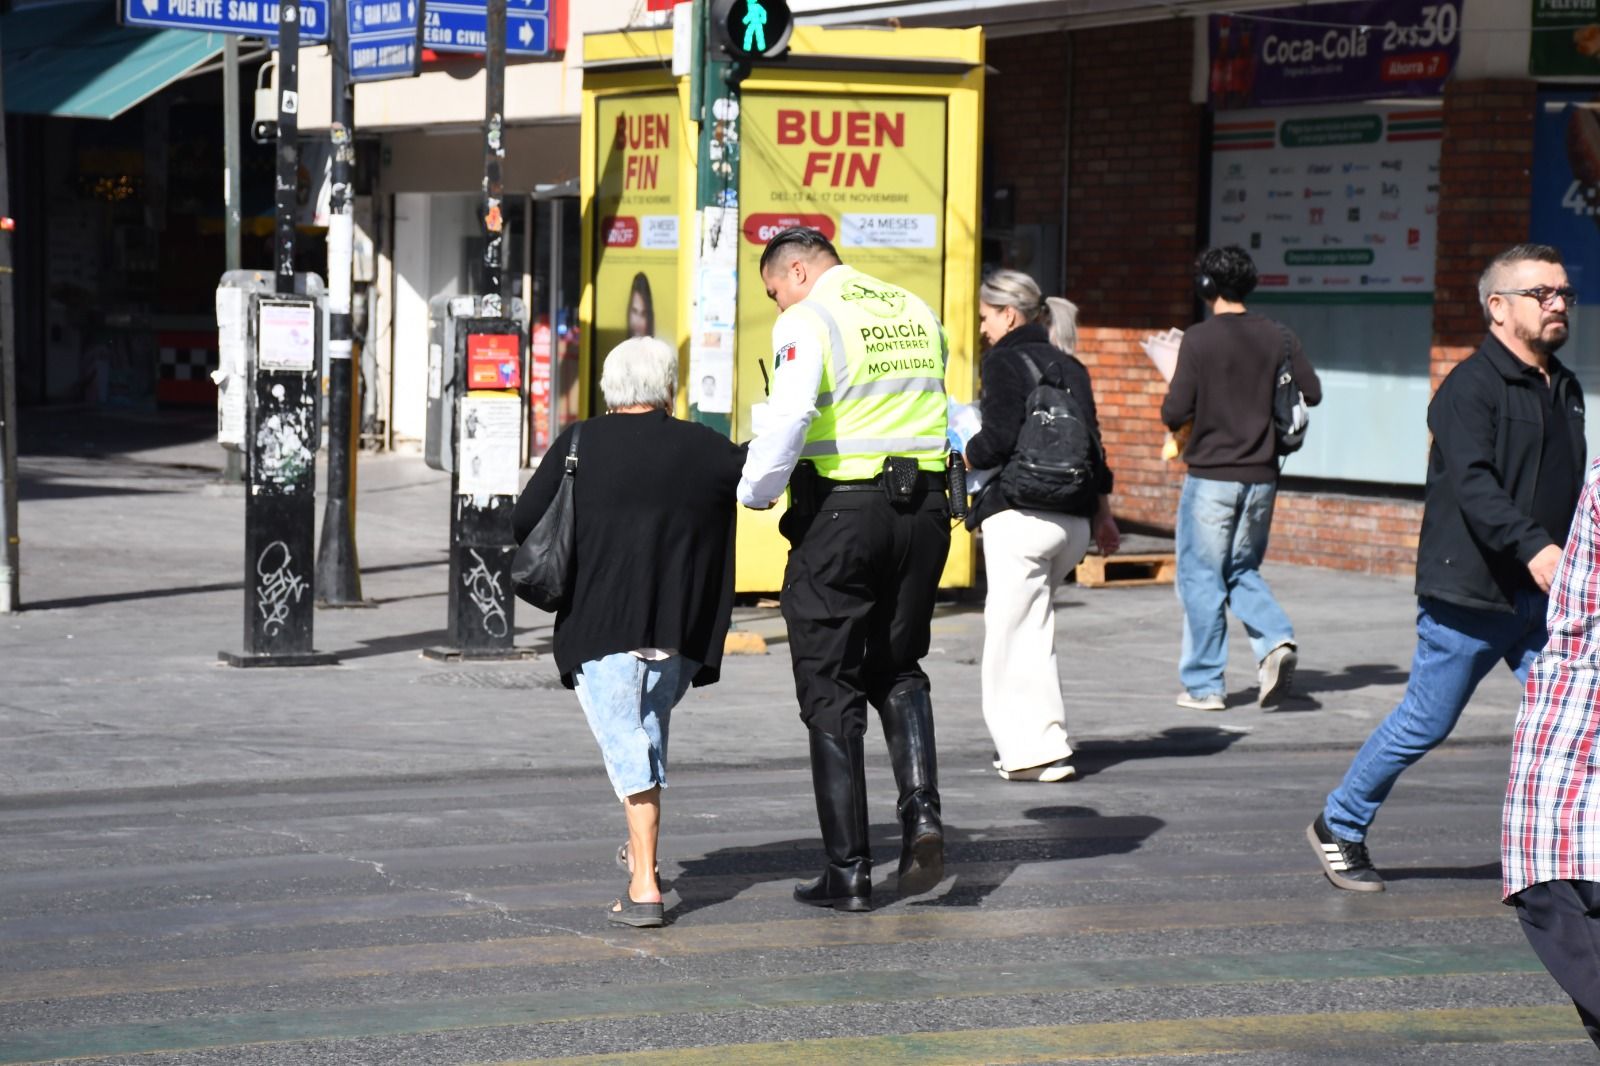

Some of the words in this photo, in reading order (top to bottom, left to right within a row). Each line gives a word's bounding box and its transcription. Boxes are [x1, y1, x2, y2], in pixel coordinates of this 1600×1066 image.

[168, 0, 223, 19] PUENTE
[228, 1, 258, 22] SAN
[263, 3, 316, 28] LUTO
[456, 29, 487, 46] CIVIL
[1262, 28, 1368, 64] Coca-Cola
[1388, 60, 1424, 76] Ahorra
[616, 114, 669, 150] BUEN
[777, 110, 904, 147] BUEN
[625, 155, 658, 190] FIN
[803, 152, 881, 187] FIN
[770, 192, 788, 202] DEL
[834, 192, 846, 202] DE
[850, 193, 909, 203] NOVIEMBRE
[860, 218, 874, 230] 24
[878, 218, 919, 230] MESES
[860, 319, 927, 341] POLICÍA
[866, 339, 929, 354] MONTERREY
[868, 358, 935, 374] MOVILIDAD
